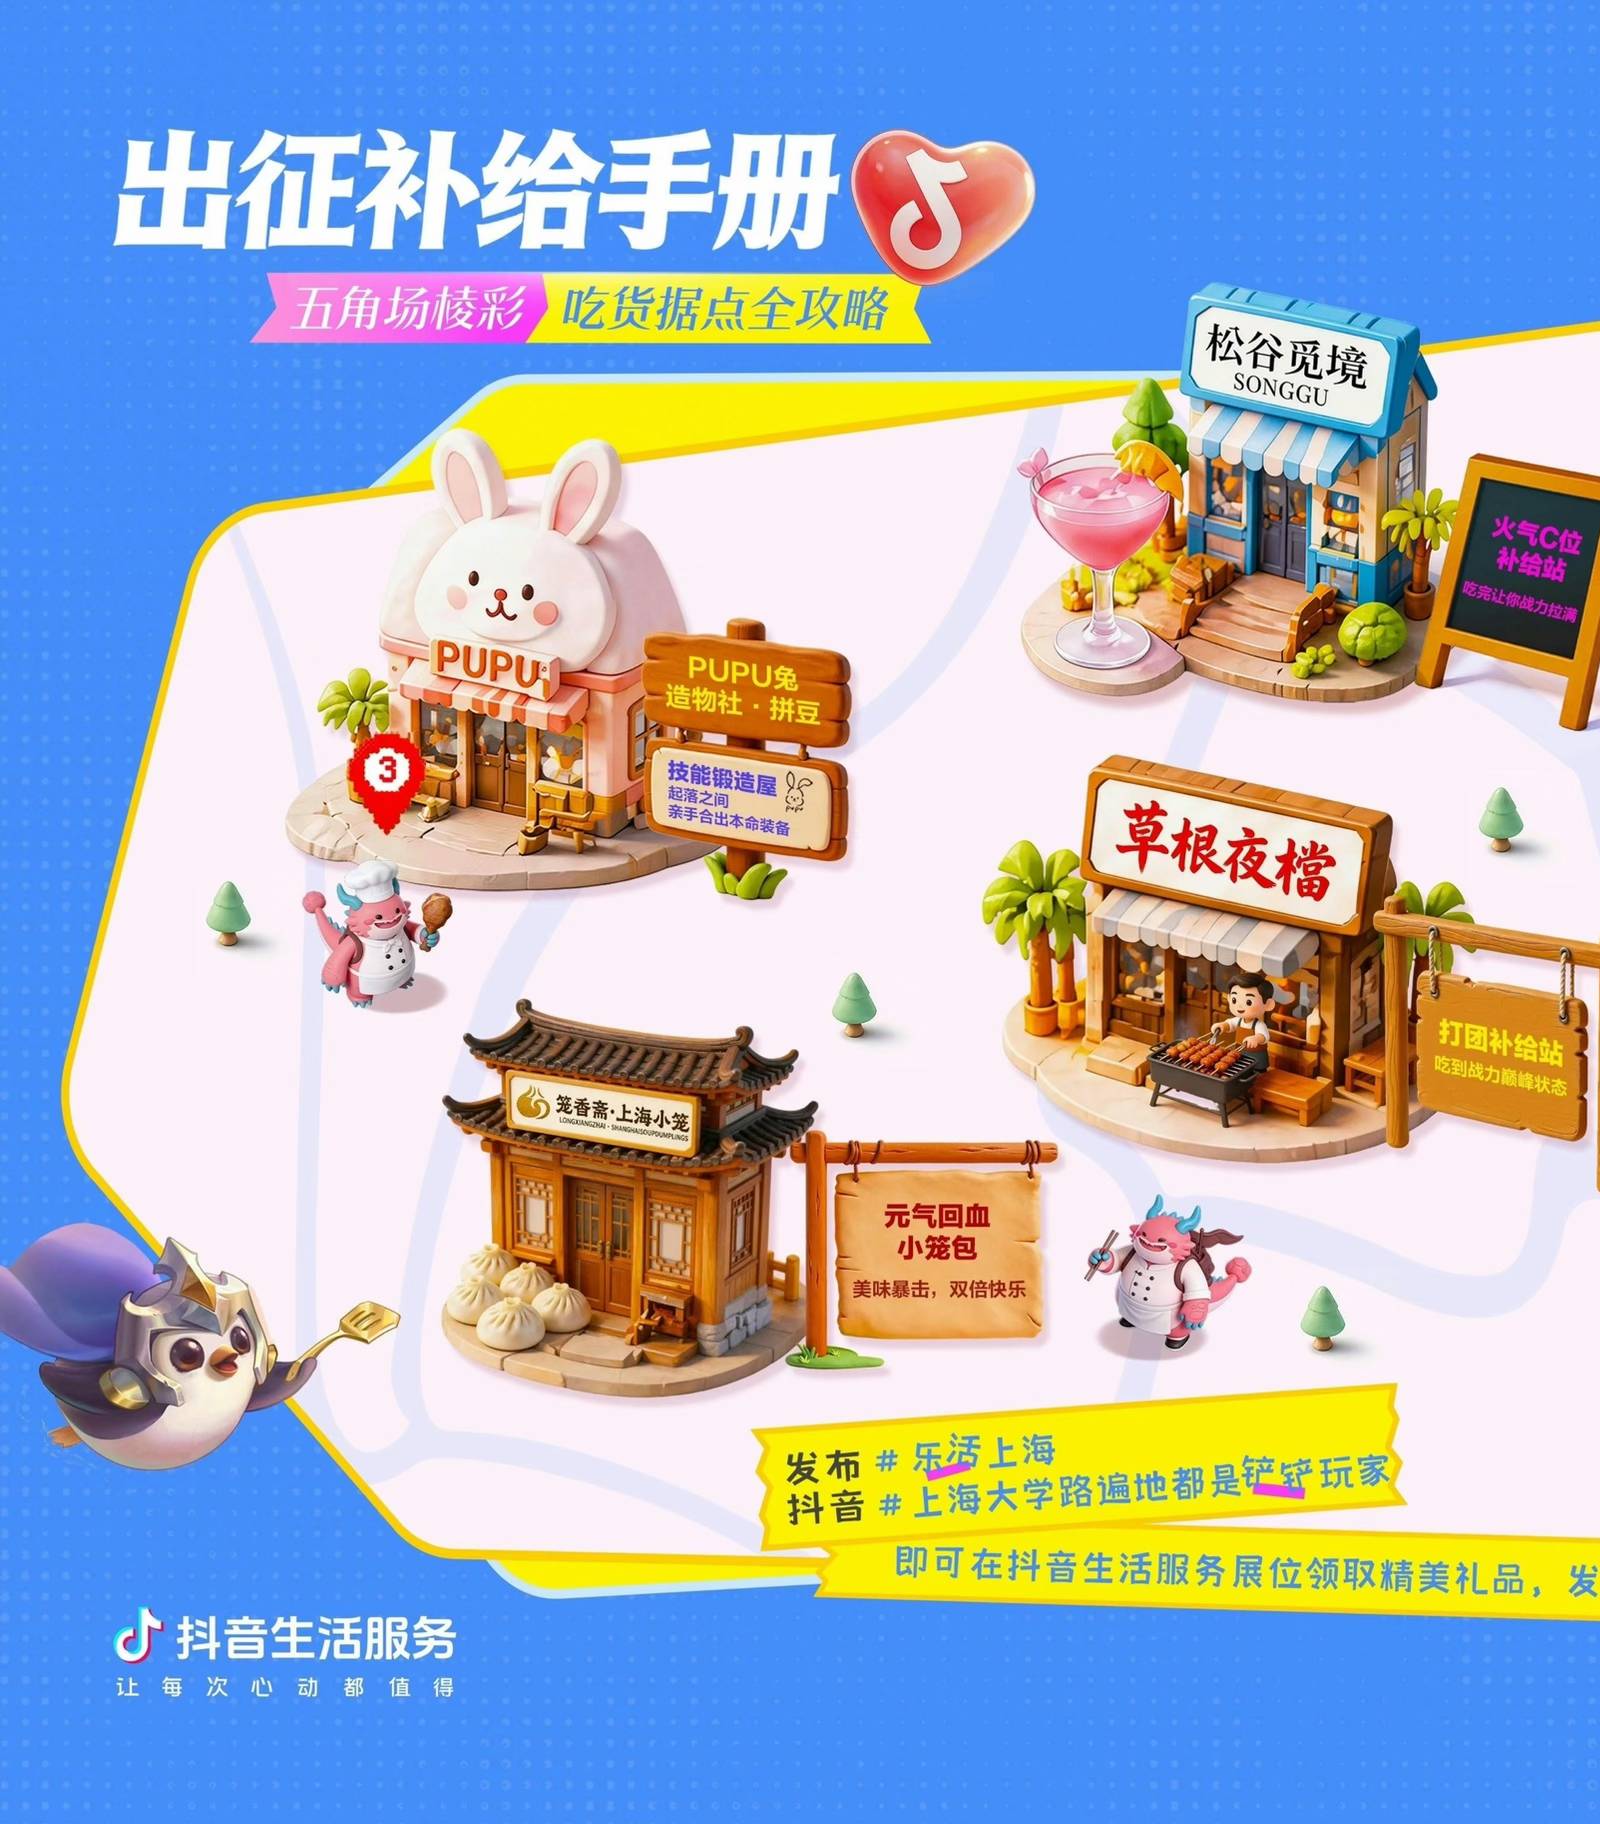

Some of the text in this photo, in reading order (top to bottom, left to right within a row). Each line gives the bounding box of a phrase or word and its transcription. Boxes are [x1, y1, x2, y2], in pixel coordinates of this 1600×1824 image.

[113, 128, 841, 253] 出征补给手册
[289, 285, 890, 333] 五角场棱彩 吃货据点全攻略
[1205, 322, 1369, 391] 松谷觅境
[1232, 372, 1329, 408] SONGGU
[1496, 546, 1568, 583] 补给站
[1462, 580, 1578, 623] 吃完让你战力拉满
[437, 639, 540, 689] PUPU
[688, 655, 799, 692] PUPU兔
[378, 755, 397, 783] 3
[667, 759, 778, 798] 技能锻造屋
[668, 785, 730, 809] 起落之间
[668, 804, 791, 837] 亲手合出本命装备
[1438, 1018, 1565, 1068] 打团补给站
[1433, 1054, 1568, 1098] 吃到战力巅峰状态
[884, 1202, 991, 1230] 元气回血
[897, 1235, 978, 1262] 小笼包
[786, 1433, 1056, 1486] 发布 乐活上海
[786, 1489, 865, 1526] 抖音
[176, 1614, 457, 1661] 抖音生活服务
